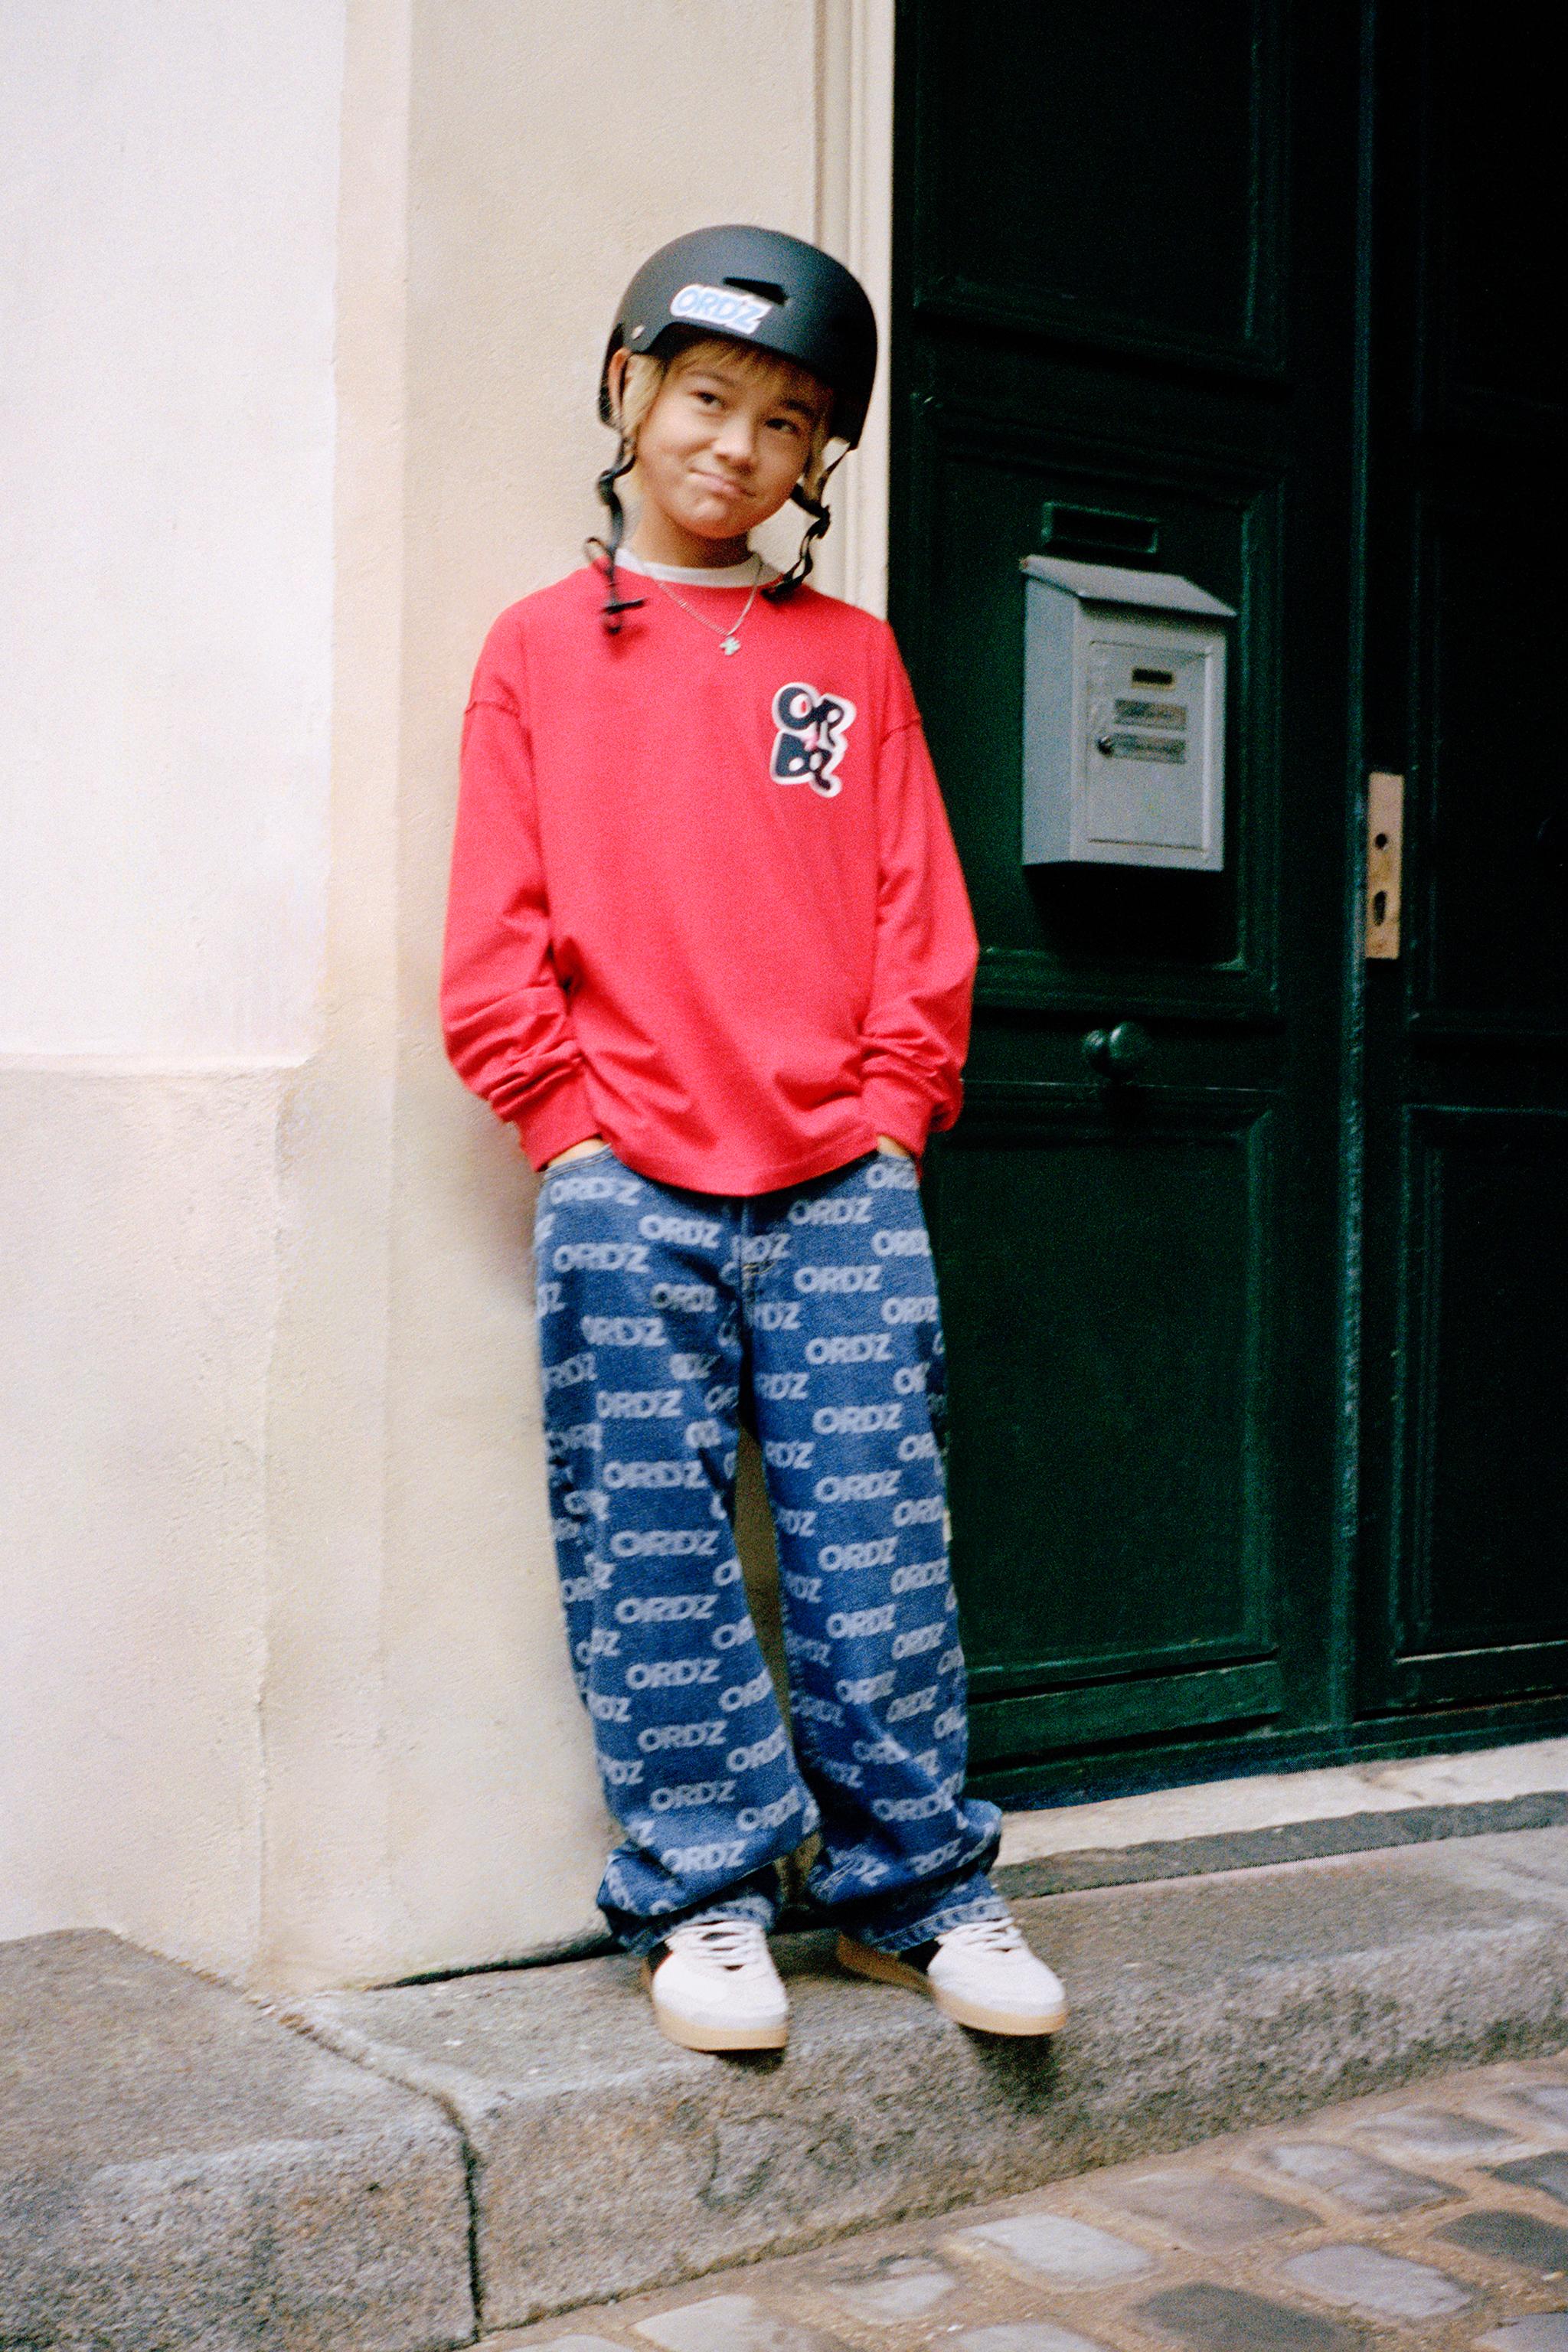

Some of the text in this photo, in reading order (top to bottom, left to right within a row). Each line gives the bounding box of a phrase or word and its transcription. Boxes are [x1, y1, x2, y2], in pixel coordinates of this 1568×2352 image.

[674, 286, 766, 331] ORDZ
[549, 1177, 645, 1206] ORDZ
[788, 1197, 874, 1226] ORDZ
[638, 1214, 723, 1249] ORDZ
[553, 1242, 650, 1273] ORDZ
[793, 1265, 882, 1294] ORDZ
[805, 1332, 893, 1364] ORDZ
[596, 1389, 684, 1418] ORDZ
[812, 1403, 903, 1435] ORDZ
[603, 1459, 710, 1489] ORDZ
[814, 1469, 902, 1503] ORDZ
[610, 1529, 720, 1557] ORDZ
[817, 1536, 900, 1571] ORDZ
[613, 1593, 720, 1623] ORDZ
[826, 1602, 897, 1639] ORDZ
[890, 1621, 947, 1660] ORDZ
[625, 1658, 721, 1690] ORDZ
[836, 1669, 897, 1705] ORDZ
[637, 1720, 727, 1753] ORDZ
[650, 1779, 737, 1811] ORDZ
[661, 1839, 747, 1873] ORDZ
